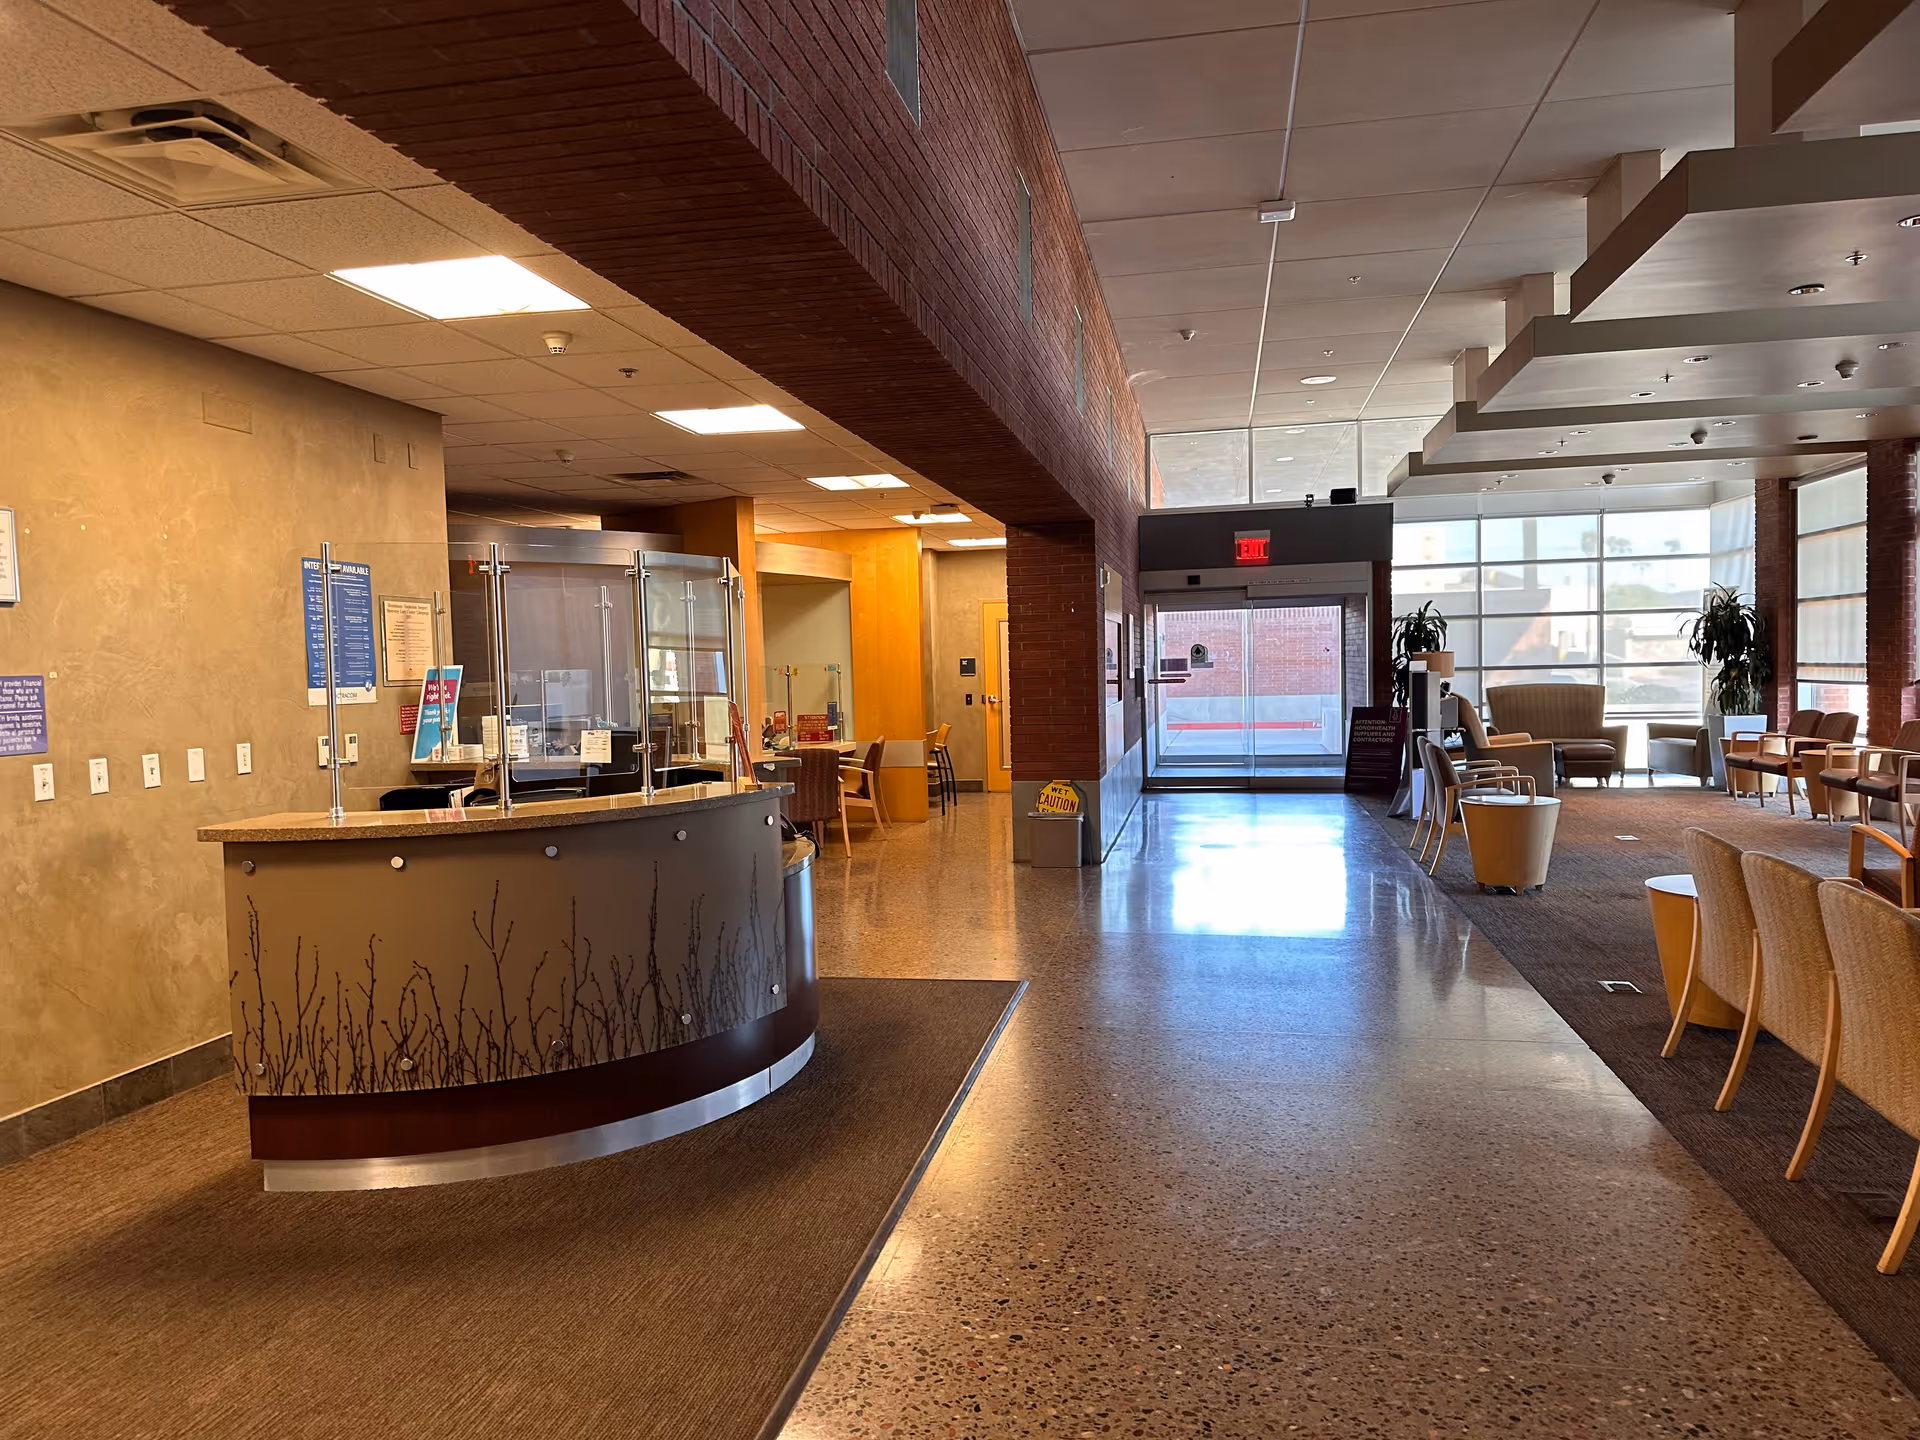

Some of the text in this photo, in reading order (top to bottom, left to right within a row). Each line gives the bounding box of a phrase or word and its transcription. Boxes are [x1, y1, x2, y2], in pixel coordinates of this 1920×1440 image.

[1240, 541, 1265, 557] EXIT
[343, 565, 369, 575] AVAILABLE
[426, 692, 439, 702] right
[17, 701, 25, 709] for
[1051, 786, 1069, 795] WET
[1038, 792, 1076, 812] CAUTION
